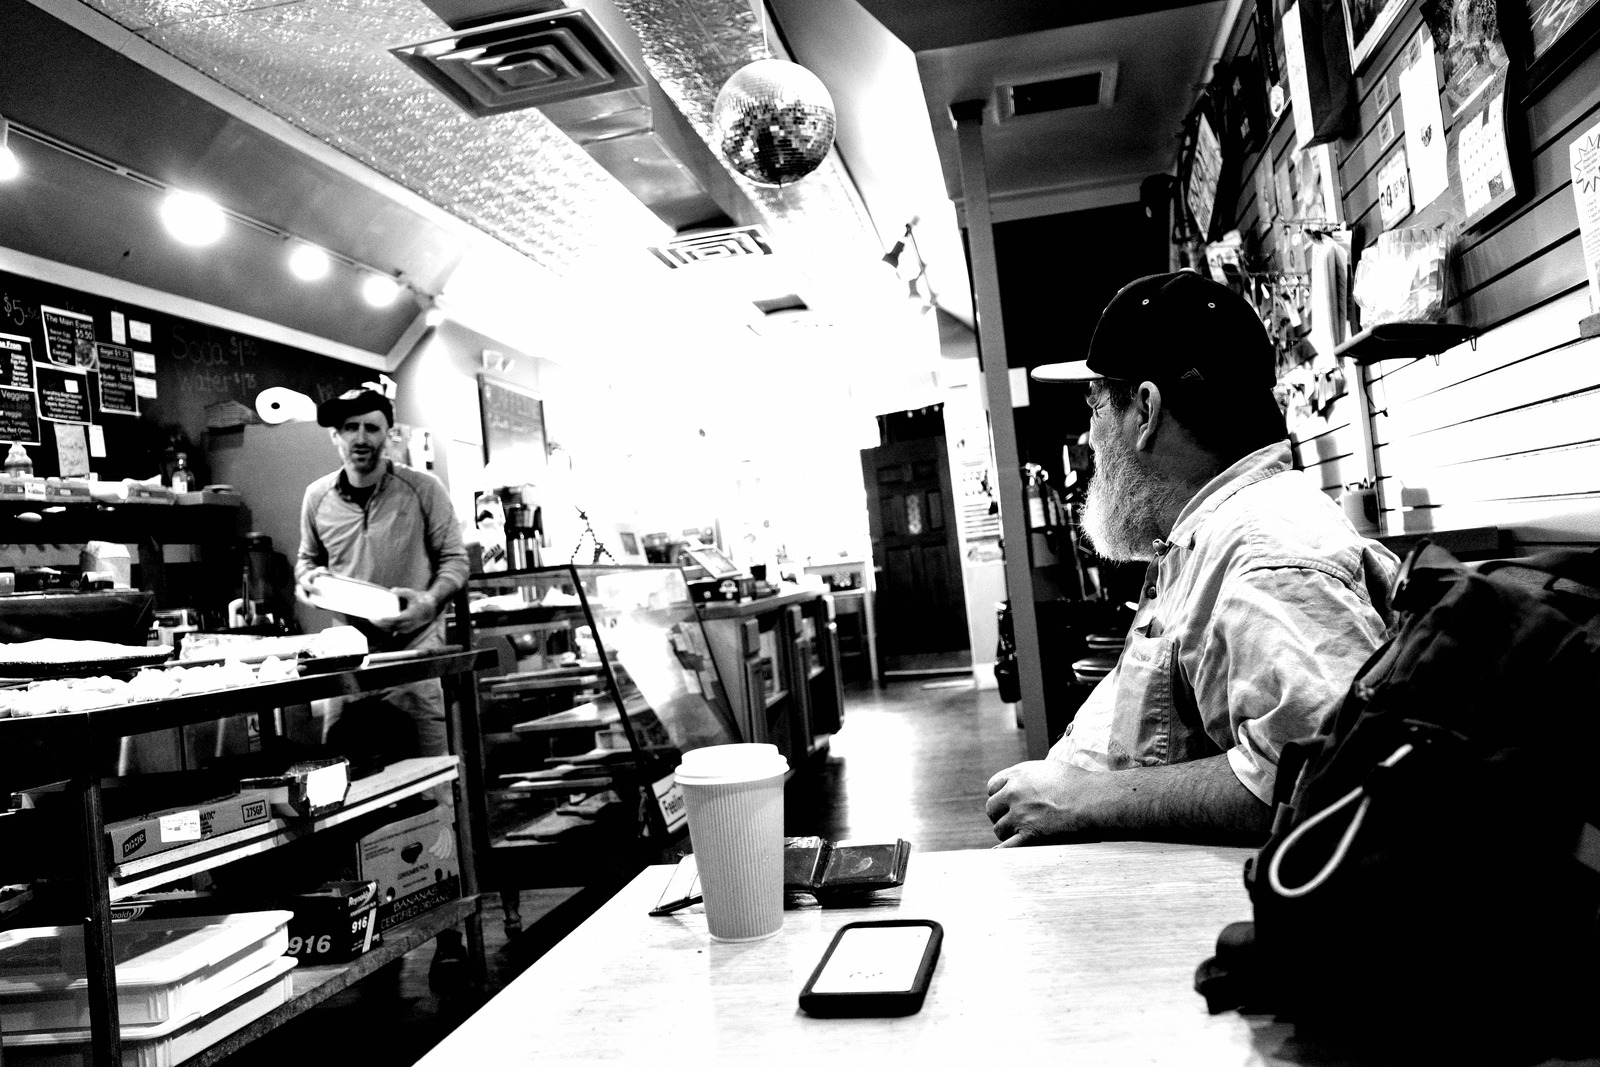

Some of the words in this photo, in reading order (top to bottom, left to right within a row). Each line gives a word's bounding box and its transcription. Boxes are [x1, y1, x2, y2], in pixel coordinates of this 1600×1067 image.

[46, 313, 58, 324] The
[59, 316, 74, 326] Main
[75, 320, 92, 330] Event
[1, 389, 30, 402] Veggies
[393, 885, 439, 913] BANANAS
[351, 916, 368, 934] 916
[381, 905, 419, 929] CERTIFIED
[287, 934, 331, 955] 916
